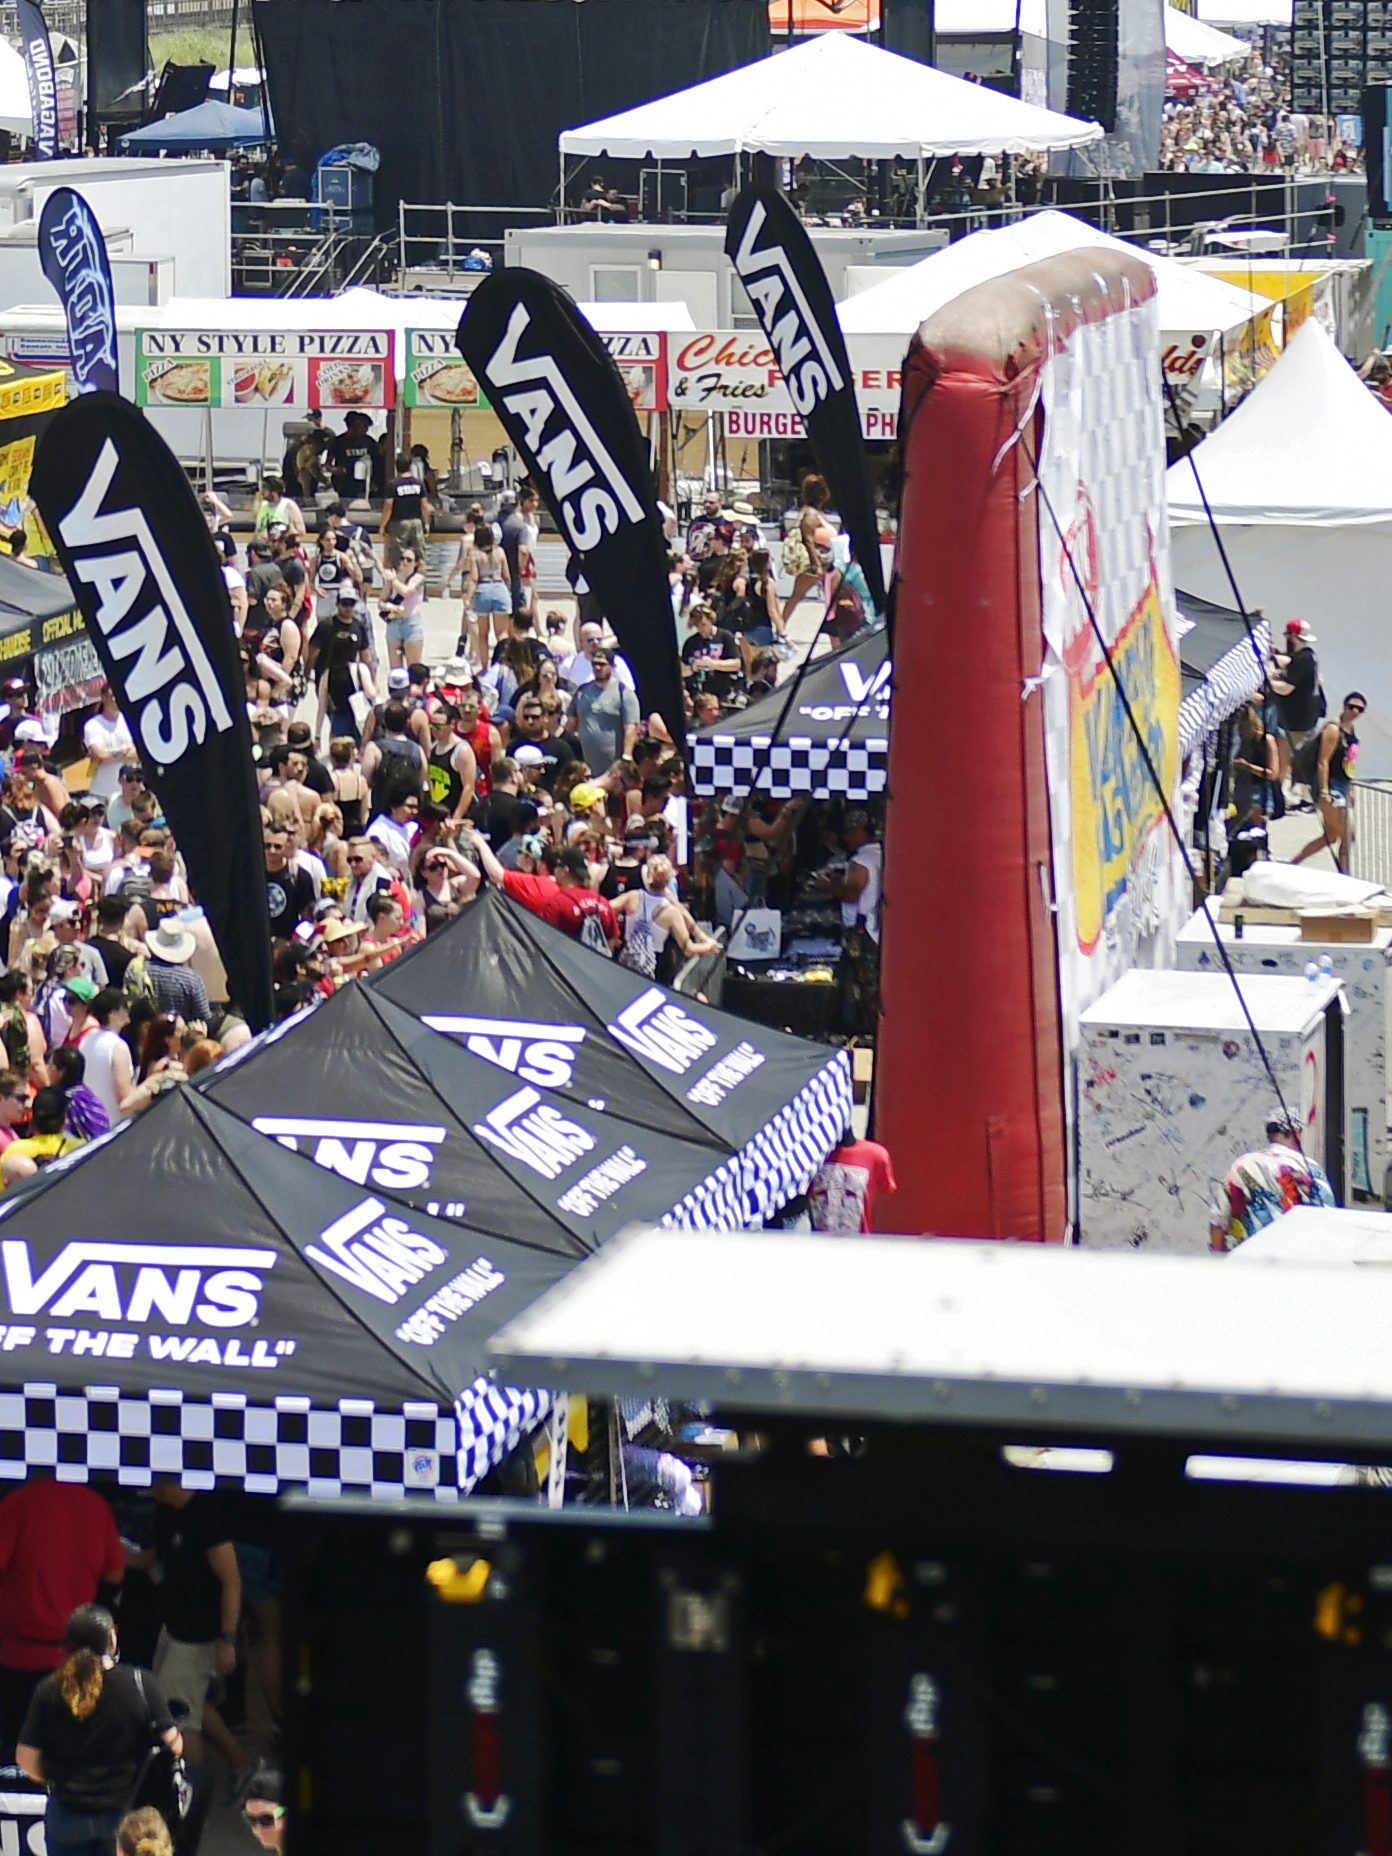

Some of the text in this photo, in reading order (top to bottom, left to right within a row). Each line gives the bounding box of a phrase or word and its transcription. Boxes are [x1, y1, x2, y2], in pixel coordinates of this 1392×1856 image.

[735, 200, 845, 417] VANS
[148, 333, 382, 355] NY STYLE PIZZA
[143, 359, 175, 382] PIZZA
[411, 359, 446, 383] PIZZA
[674, 372, 771, 401] & Fries
[486, 302, 645, 552] VANS
[729, 411, 804, 435] BURGE
[59, 438, 234, 764] VANS
[42, 614, 72, 643] OFFICIAL
[608, 986, 718, 1074] VANS
[706, 1062, 745, 1089] THE
[474, 1085, 597, 1180] VANS
[578, 1169, 621, 1200] THE
[306, 1196, 448, 1304] VANS
[0, 1239, 277, 1329] VANS
[425, 1285, 474, 1321] THE
[55, 1325, 160, 1361] THE
[167, 1334, 295, 1369] WALL"
